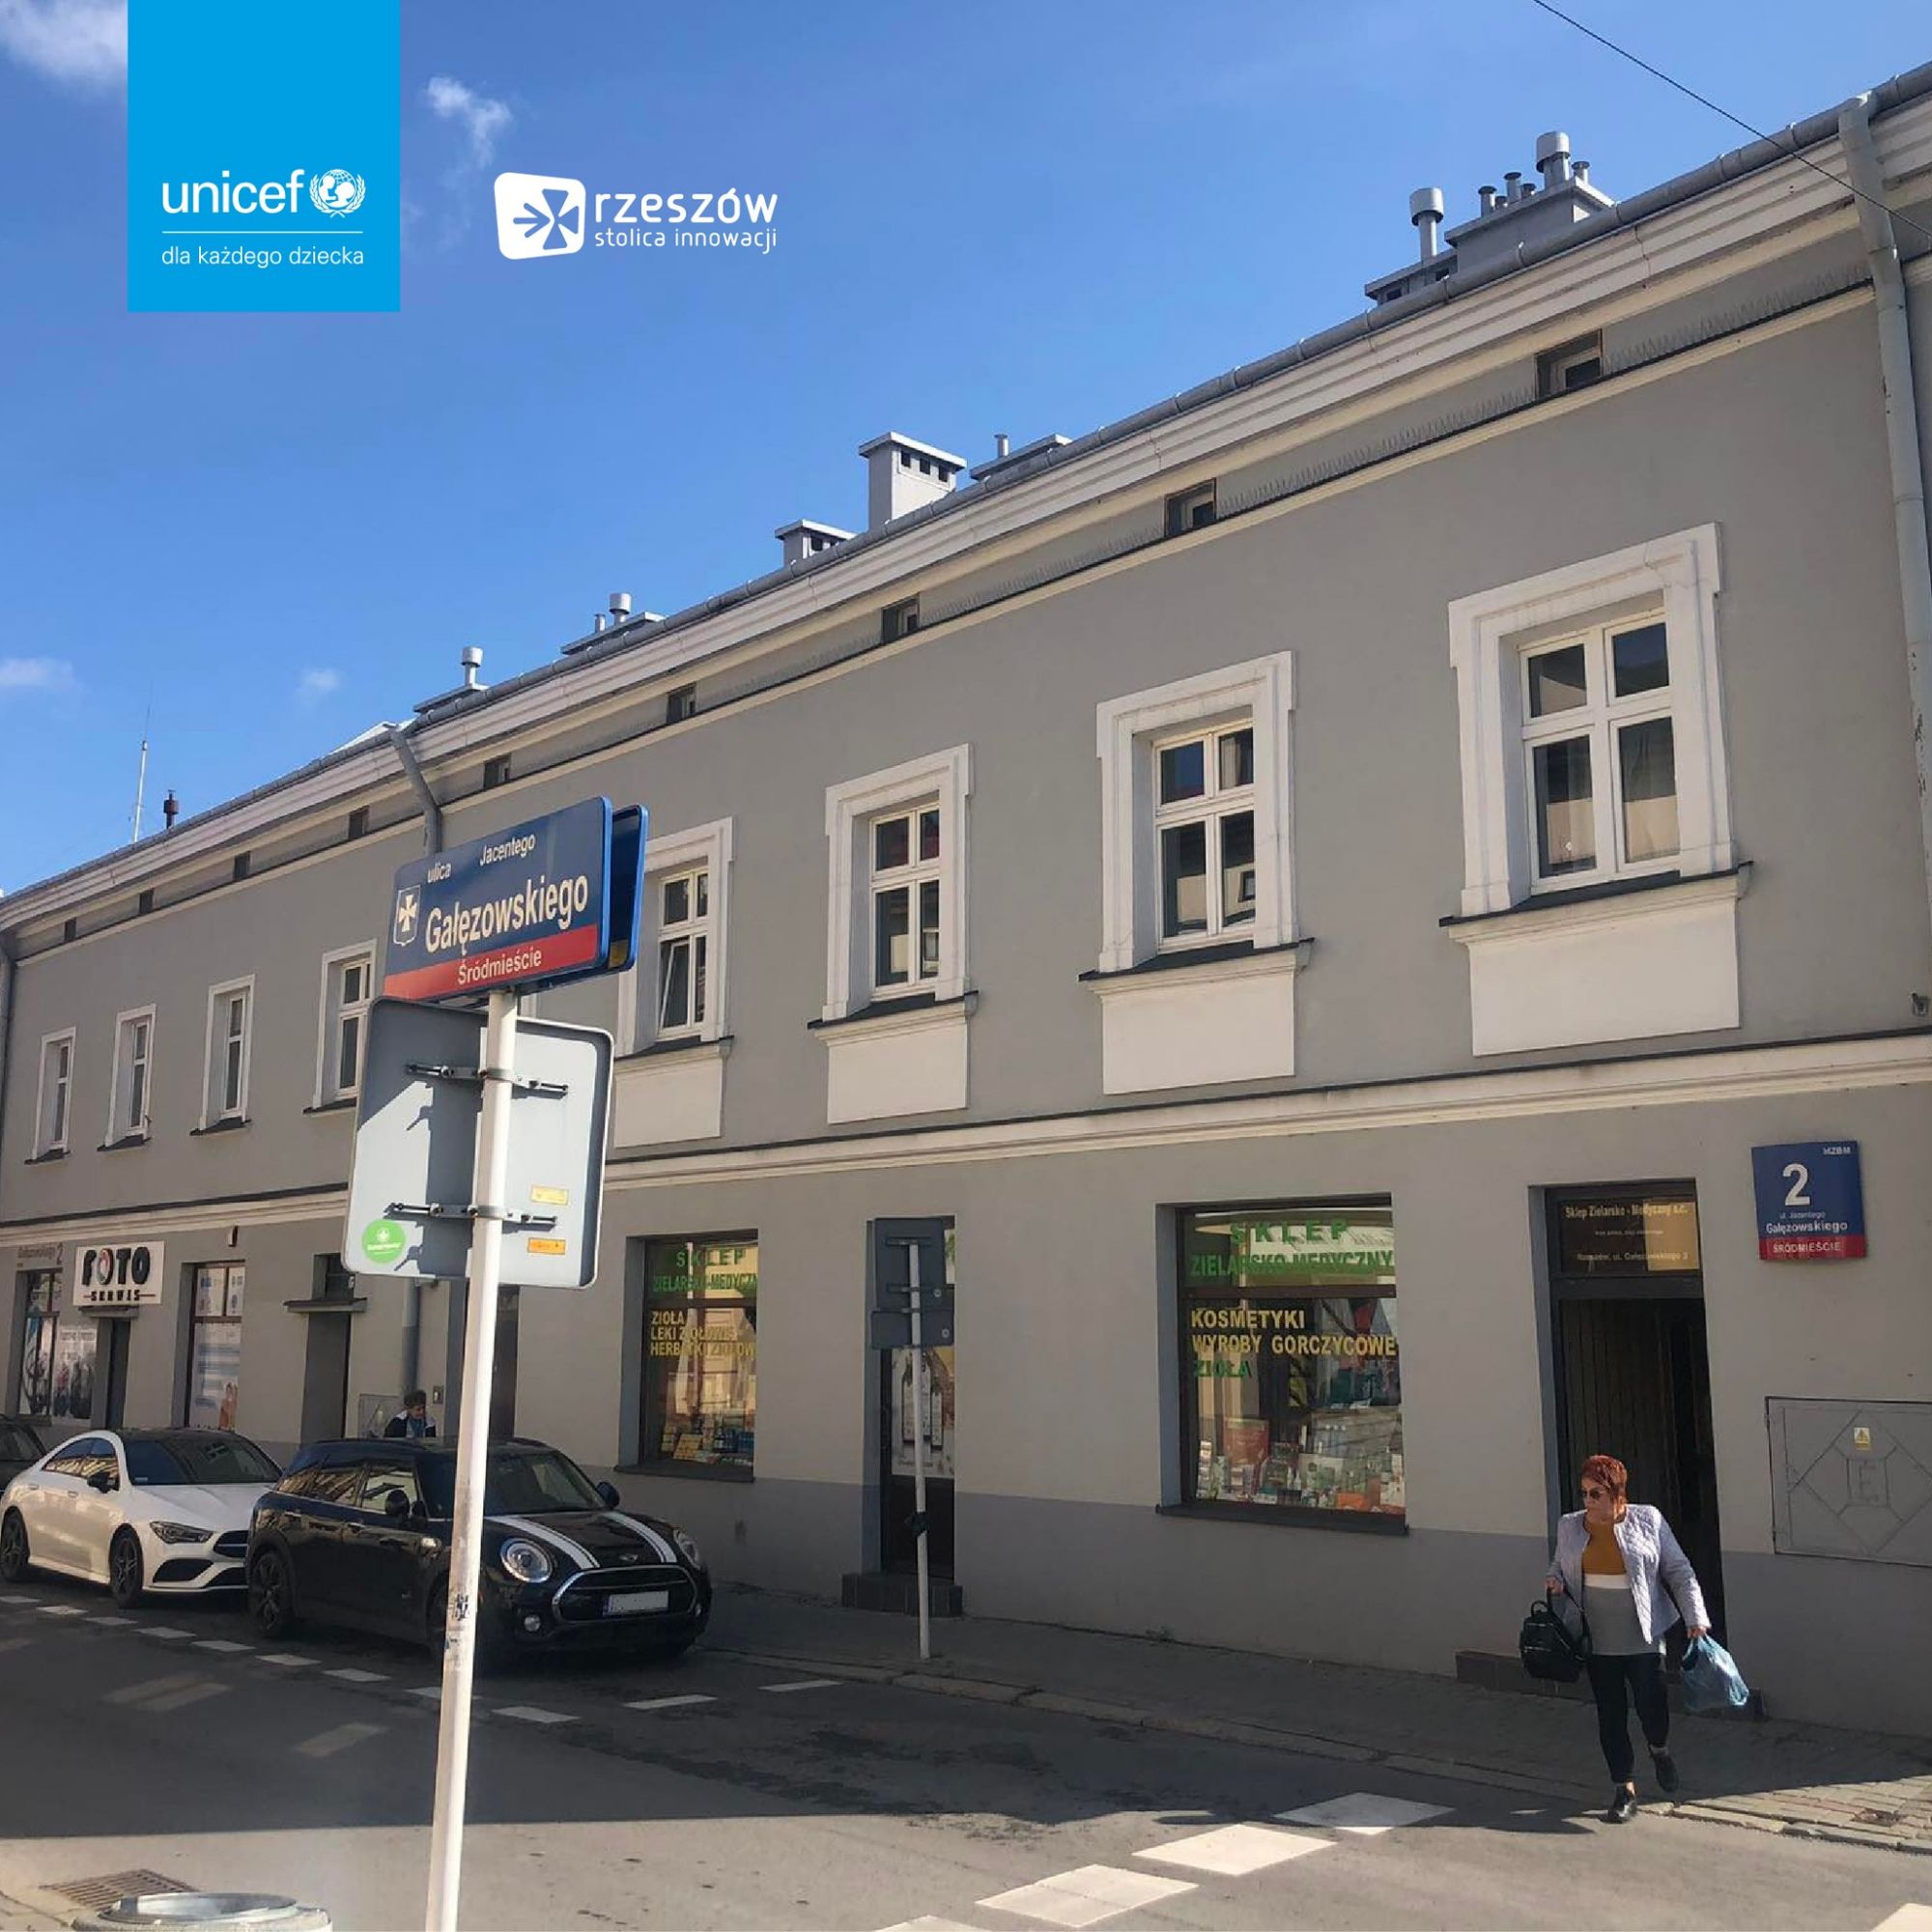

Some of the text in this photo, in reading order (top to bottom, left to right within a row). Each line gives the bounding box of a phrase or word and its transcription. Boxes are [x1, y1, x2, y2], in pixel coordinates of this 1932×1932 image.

[427, 834, 536, 883] ulica Jacentego
[425, 874, 588, 955] Gałęzowskiego
[457, 947, 542, 985] Śródmieście
[1782, 1163, 1811, 1207] 2
[1231, 1219, 1348, 1246] SKLEP
[1766, 1220, 1848, 1235] Gałęzowskiego
[676, 1247, 746, 1267] SKLEP
[1773, 1240, 1841, 1254] ŚRÓDMIEŚCIE
[82, 1246, 151, 1286] FOTO
[91, 1289, 141, 1301] SERWIS
[652, 1310, 685, 1325] ZIOŁA
[1191, 1310, 1305, 1329] KOSMETYKI
[651, 1326, 676, 1341] LEKI
[1192, 1334, 1397, 1356] WYROBY GORCZYCOWE
